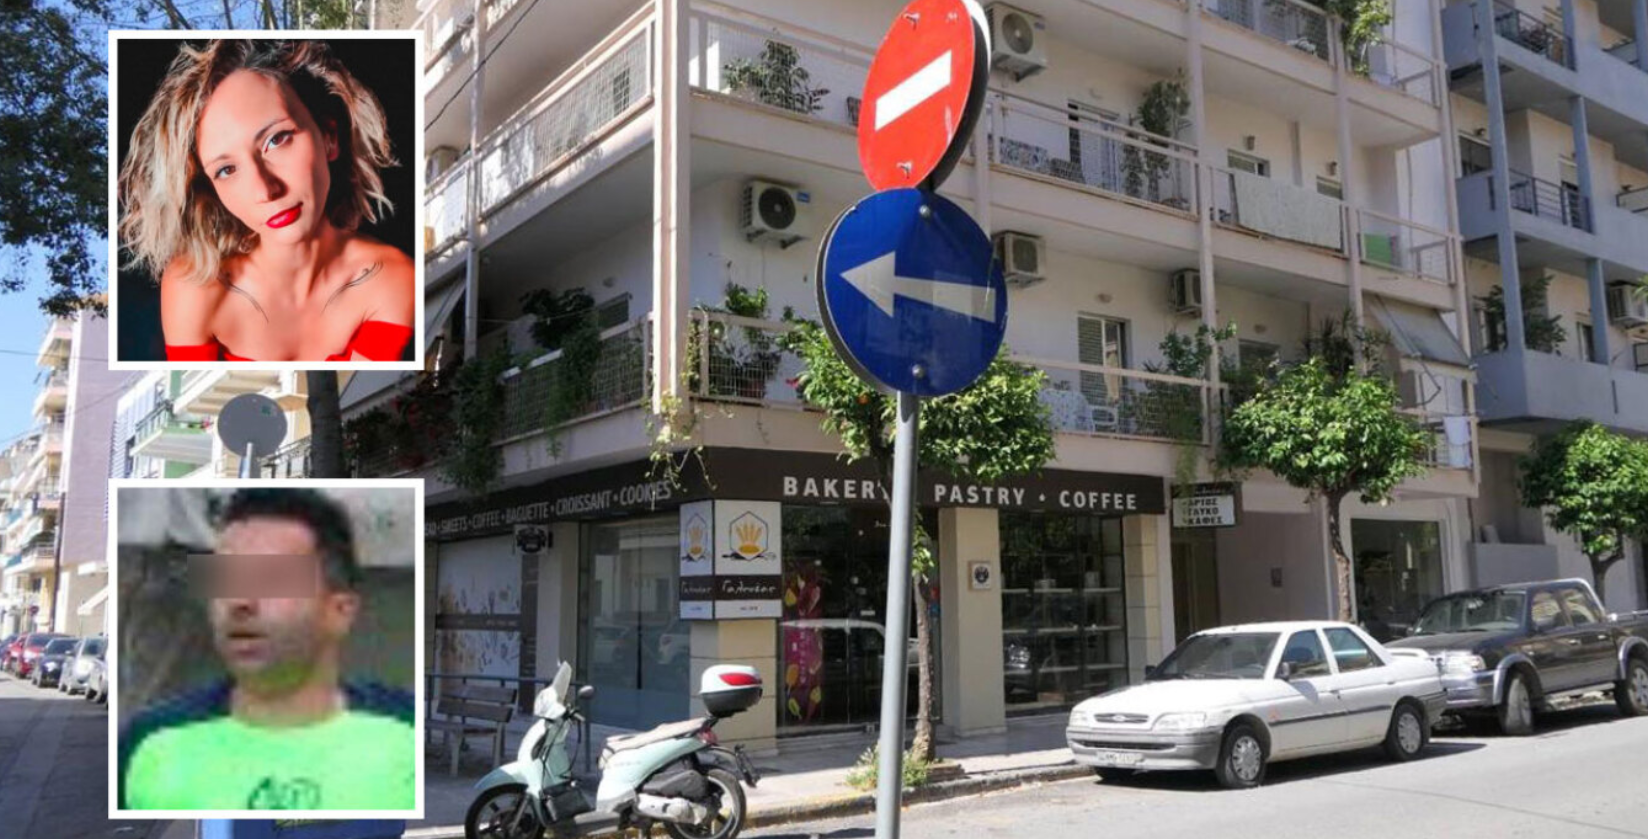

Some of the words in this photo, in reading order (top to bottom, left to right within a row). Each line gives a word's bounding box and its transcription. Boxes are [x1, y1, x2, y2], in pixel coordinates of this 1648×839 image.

[473, 509, 500, 529] COFFEE
[506, 501, 549, 524] BAGUETTE
[555, 490, 612, 516] CROISSANT
[619, 480, 671, 506] COOKIES
[934, 484, 1025, 505] PASTRY
[1059, 490, 1137, 510] COFFEE
